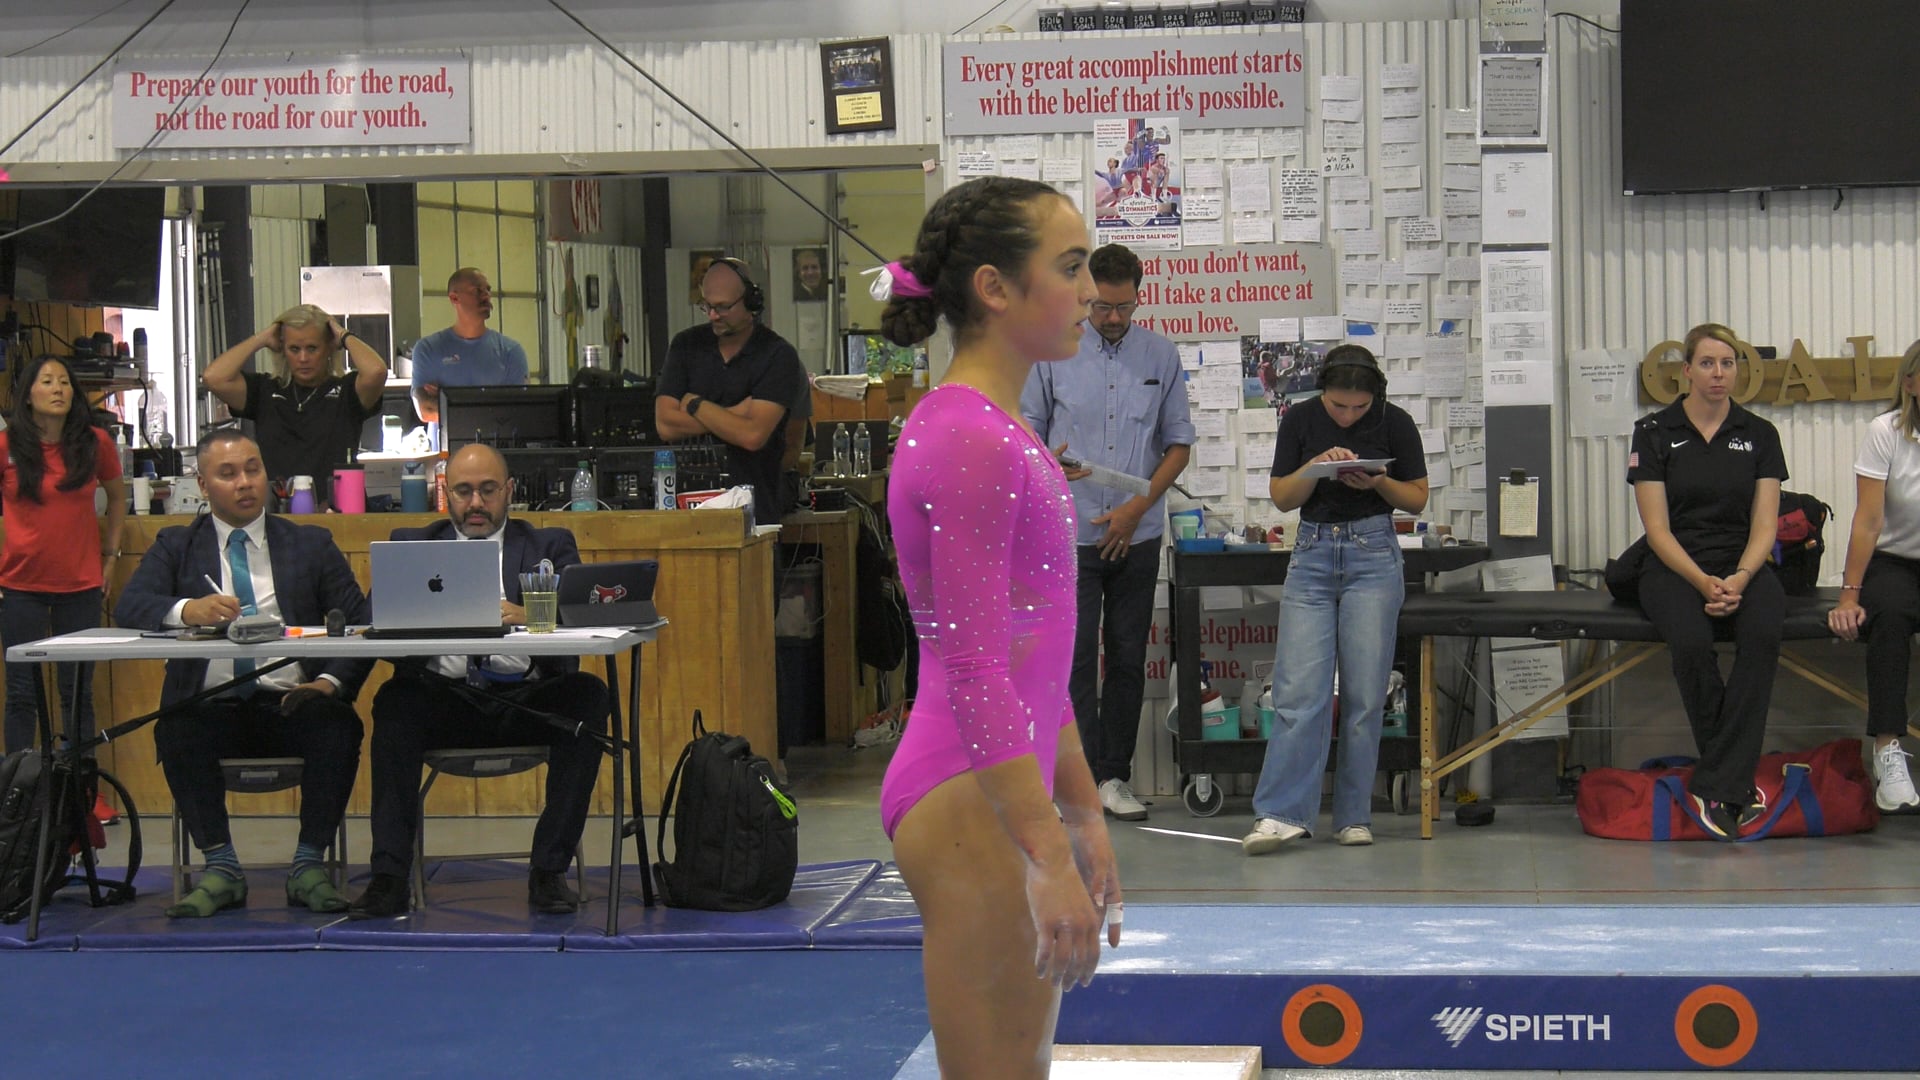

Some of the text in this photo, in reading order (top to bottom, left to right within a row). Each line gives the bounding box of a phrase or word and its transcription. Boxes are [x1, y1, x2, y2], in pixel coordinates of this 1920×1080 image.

[960, 48, 1302, 88] Every great accomplishment starts
[131, 67, 453, 104] Prepare our youth for the road,
[979, 82, 1284, 118] with the belief that it's possible.
[155, 102, 427, 135] not the road for our youth.
[1167, 257, 1199, 281] you
[1203, 250, 1249, 274] don't
[1254, 250, 1307, 276] want,
[1138, 279, 1313, 306] ell take a chance at
[1131, 311, 1239, 336] at you love.
[1728, 441, 1744, 451] USA
[664, 475, 675, 510] ore
[1200, 618, 1279, 651] elephan
[1147, 656, 1167, 680] at
[1200, 652, 1246, 680] me.
[1485, 1013, 1610, 1041] SPIETH
